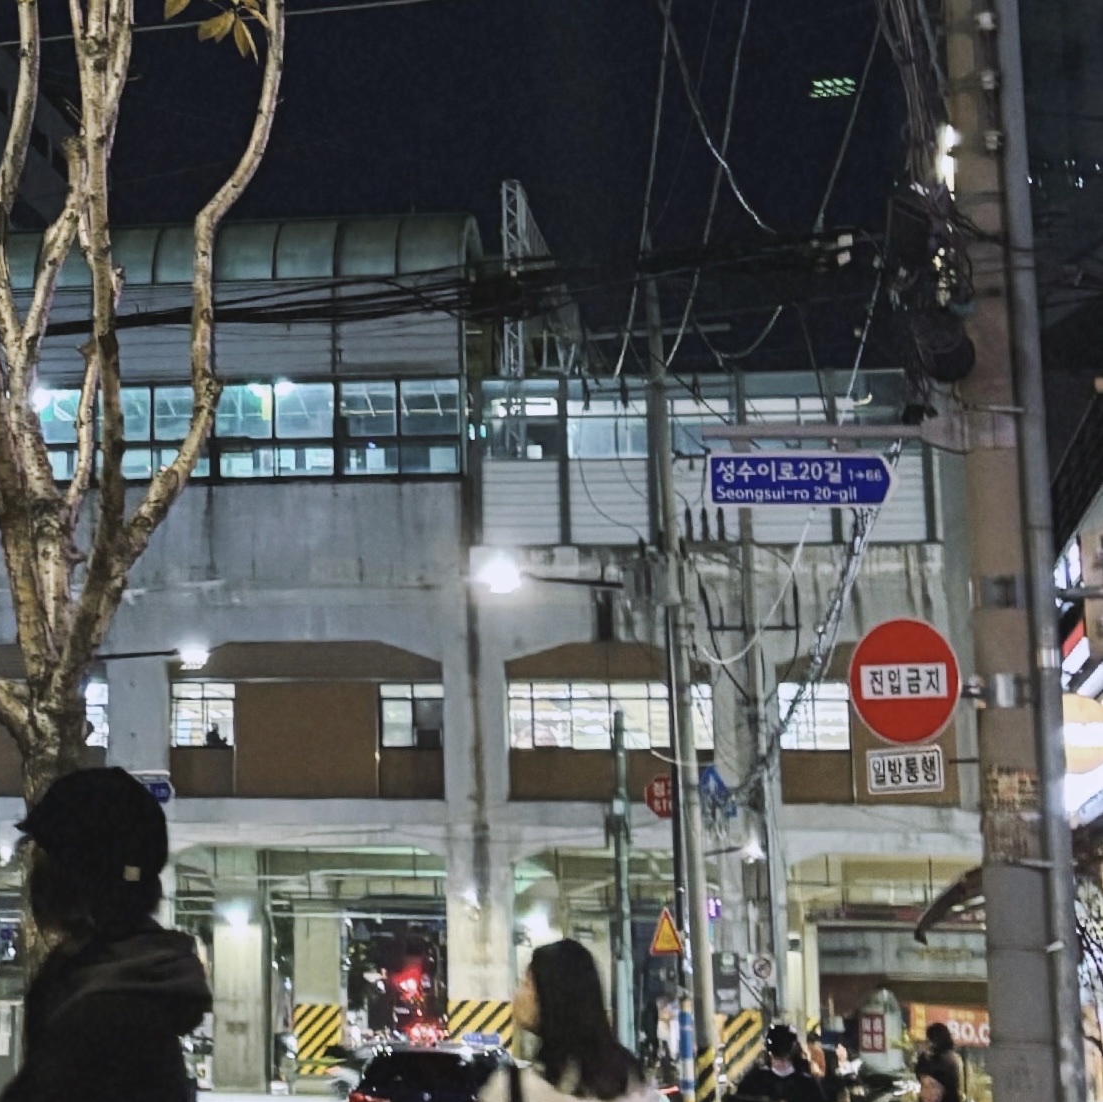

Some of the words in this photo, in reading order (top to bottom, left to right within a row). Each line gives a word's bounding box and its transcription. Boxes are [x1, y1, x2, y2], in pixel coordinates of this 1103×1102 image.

[716, 460, 842, 483] 성수이로20길
[716, 485, 810, 501] Seongsui-ro
[814, 486, 858, 501] 20-gil
[869, 667, 941, 695] 진입금지
[873, 754, 937, 786] 일방통행
